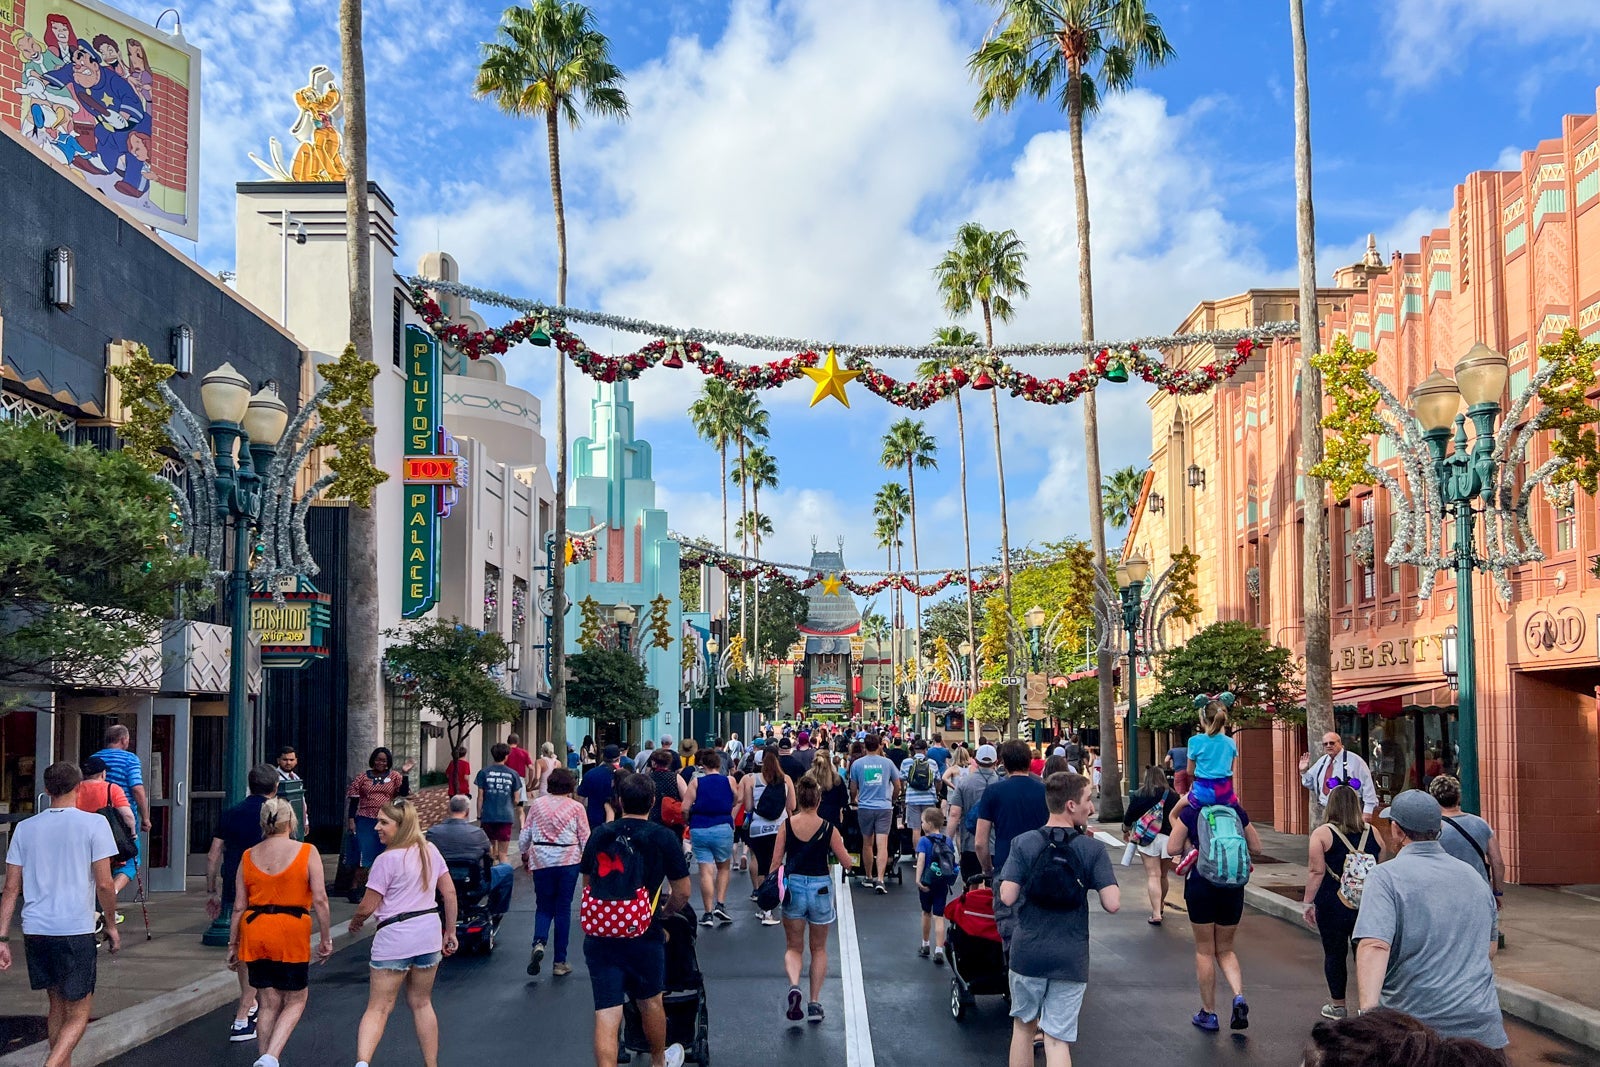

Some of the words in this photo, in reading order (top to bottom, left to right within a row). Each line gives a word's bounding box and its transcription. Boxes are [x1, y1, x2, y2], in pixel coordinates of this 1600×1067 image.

[407, 461, 453, 477] TOY
[410, 494, 426, 598] PALACE
[252, 608, 306, 630] FASHION
[1296, 634, 1443, 676] CLEBRITY
